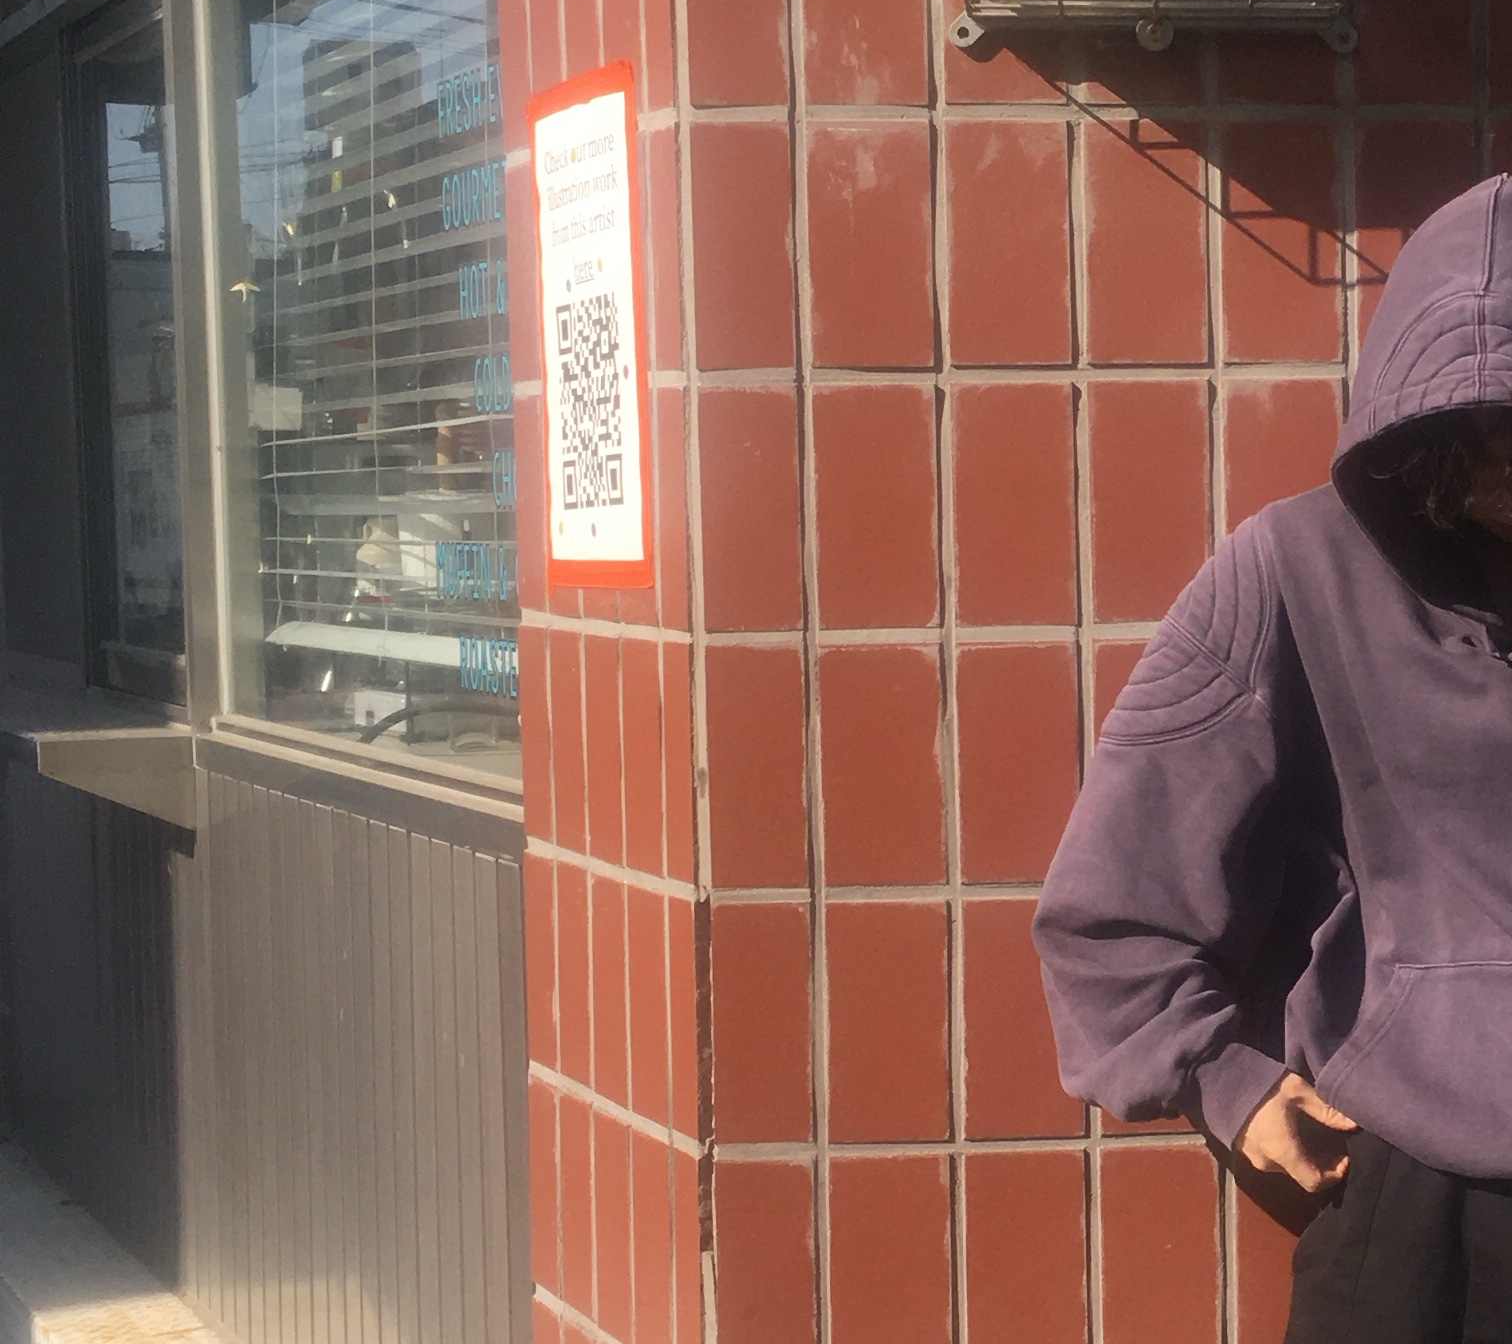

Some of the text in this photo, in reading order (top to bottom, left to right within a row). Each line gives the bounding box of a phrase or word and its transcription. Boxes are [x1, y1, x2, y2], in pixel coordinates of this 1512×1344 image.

[436, 66, 482, 139] FRESH
[544, 144, 569, 175] Check
[588, 133, 614, 159] more
[592, 163, 618, 194] work
[552, 205, 615, 247] from this artist
[459, 261, 488, 321] HOT
[573, 257, 594, 284] here
[475, 356, 512, 412] COLD
[493, 451, 518, 505] CH
[436, 541, 491, 598] MUFFIN
